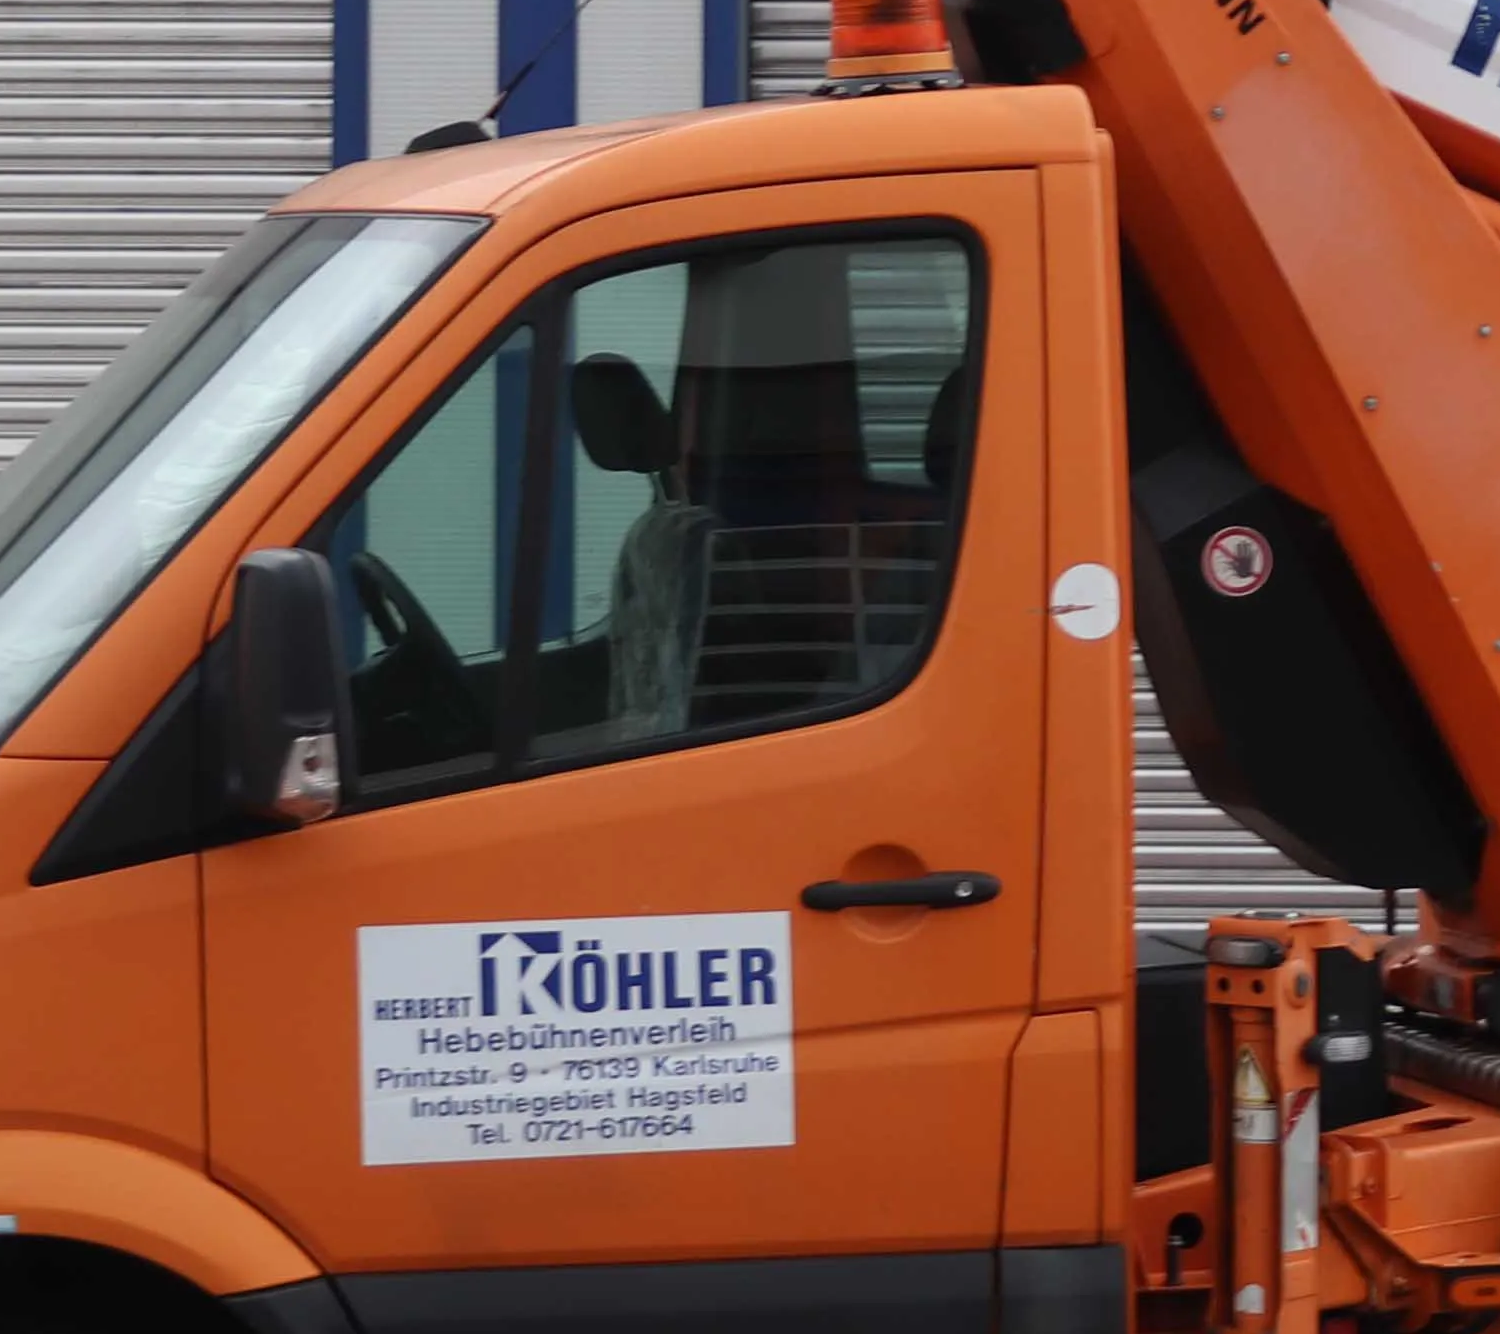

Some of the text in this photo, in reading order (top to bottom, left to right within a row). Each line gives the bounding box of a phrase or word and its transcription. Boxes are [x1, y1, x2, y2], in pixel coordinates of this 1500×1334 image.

[374, 931, 778, 1022] HERBERT KÖHLER
[418, 1016, 737, 1056] Hebebühnenverleih
[375, 1064, 498, 1091] Printzstr.
[511, 1061, 529, 1085] 9
[562, 1055, 641, 1082] 76139
[653, 1051, 780, 1078] Karlsruhe
[411, 1082, 748, 1119] Industriegebiet Hagsfeld
[466, 1113, 694, 1146] Tel. 0721-617664
